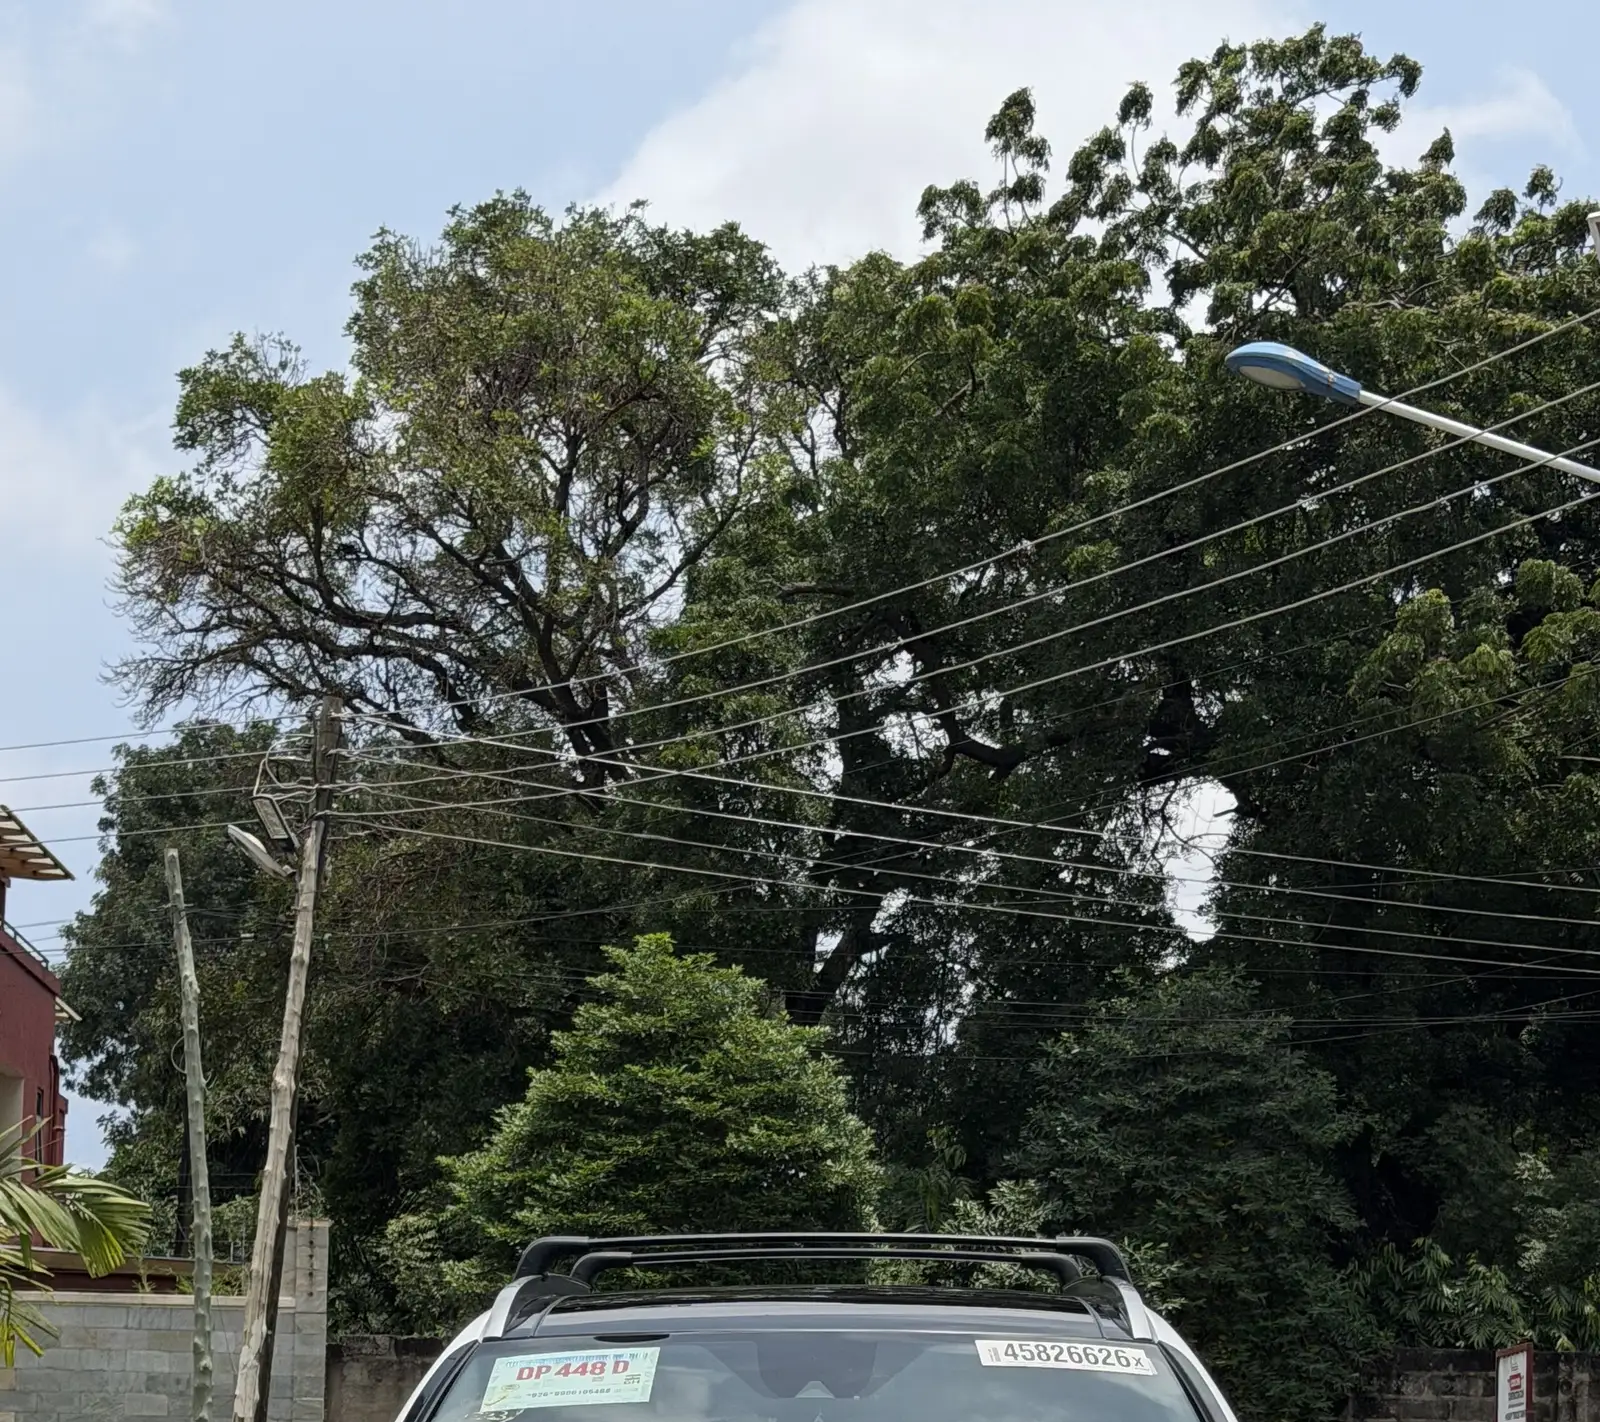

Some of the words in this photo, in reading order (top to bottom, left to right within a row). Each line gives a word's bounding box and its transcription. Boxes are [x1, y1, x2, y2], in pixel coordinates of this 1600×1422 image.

[516, 1365, 552, 1380] DP
[554, 1361, 607, 1378] 448
[612, 1360, 630, 1374] D
